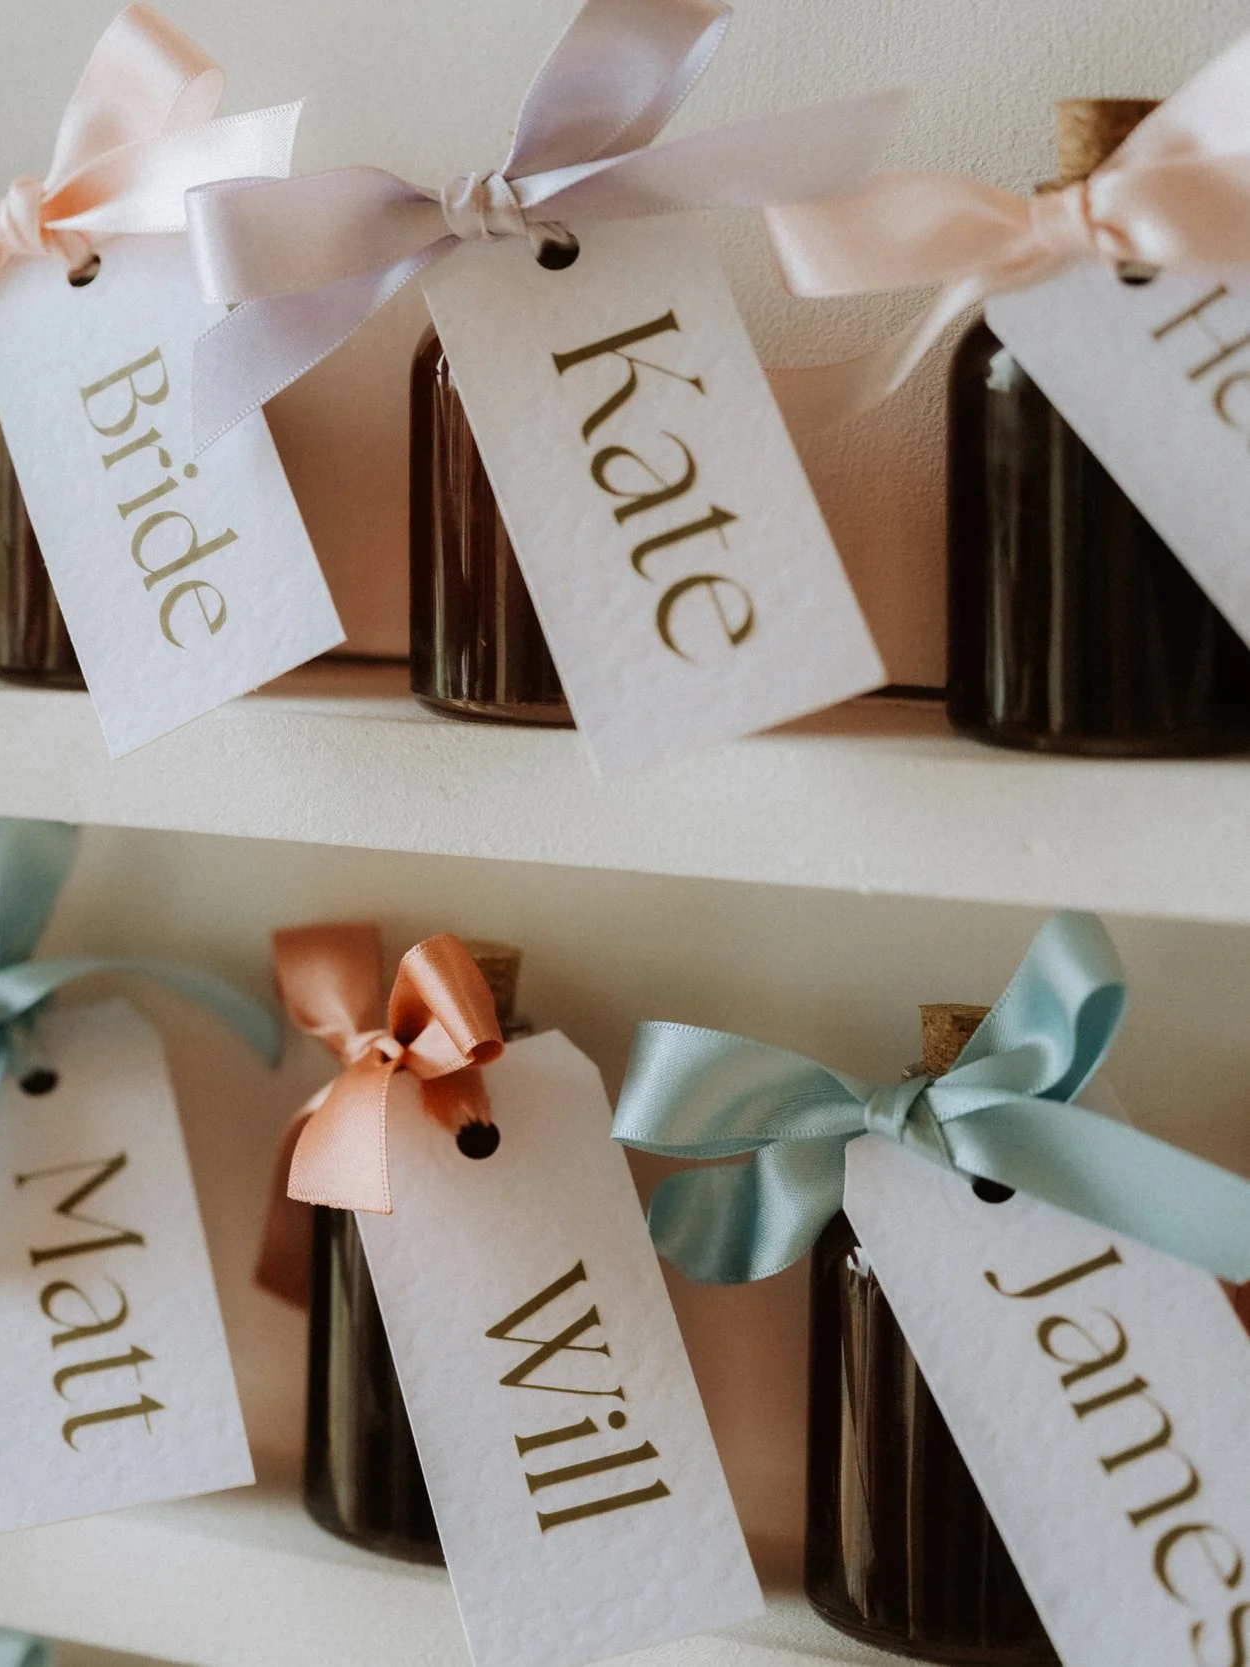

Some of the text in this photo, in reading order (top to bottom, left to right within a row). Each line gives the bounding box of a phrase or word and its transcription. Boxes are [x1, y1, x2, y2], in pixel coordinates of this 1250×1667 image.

[79, 346, 239, 651] Bride
[551, 309, 758, 664] Kate
[14, 1150, 166, 1454] Matt
[485, 1259, 672, 1535] Will
